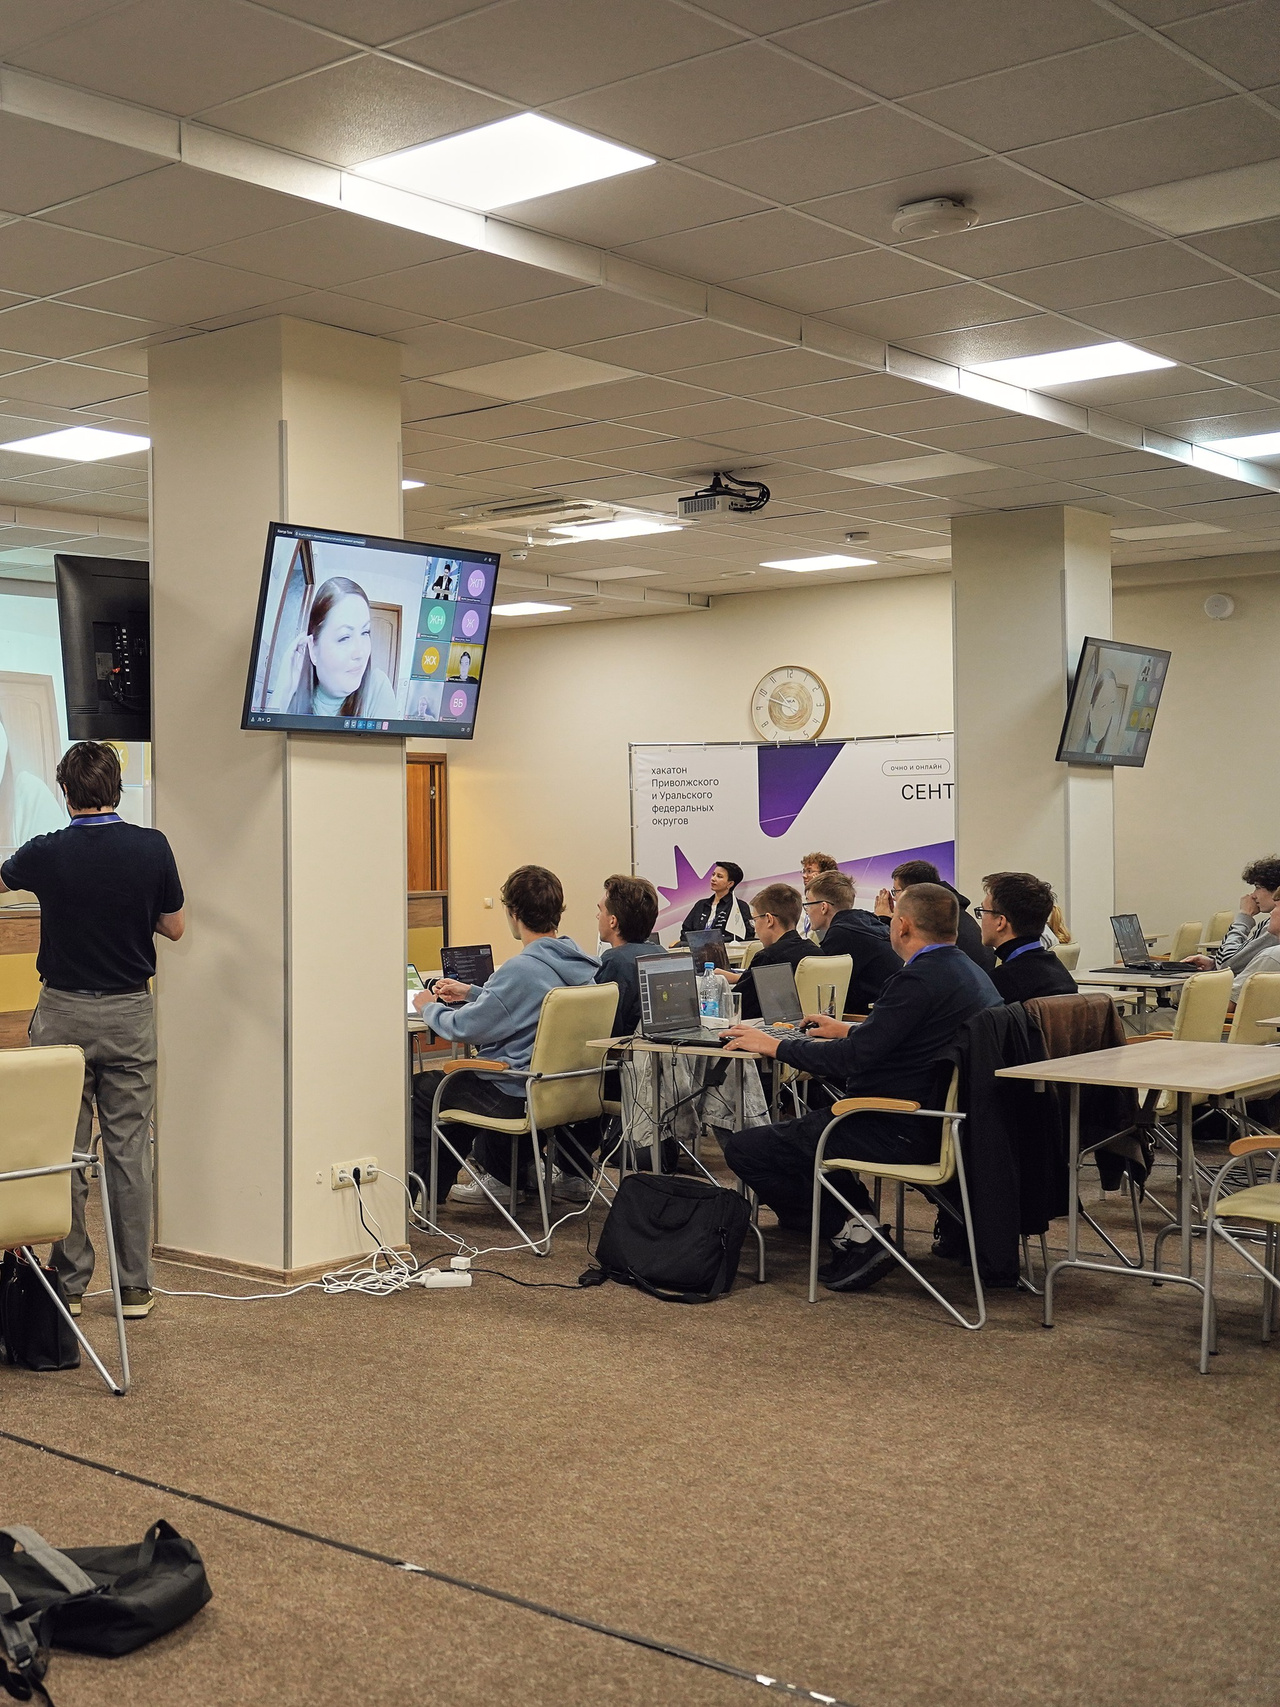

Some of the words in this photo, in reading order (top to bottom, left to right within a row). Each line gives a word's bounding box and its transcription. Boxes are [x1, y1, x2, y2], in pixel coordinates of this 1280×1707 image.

[651, 767, 687, 775] хакатон
[651, 779, 719, 789] Приволжского
[660, 791, 713, 801] Уральского
[901, 783, 955, 800] СЕНТ
[651, 805, 714, 814] федеральных
[652, 818, 689, 827] округов
